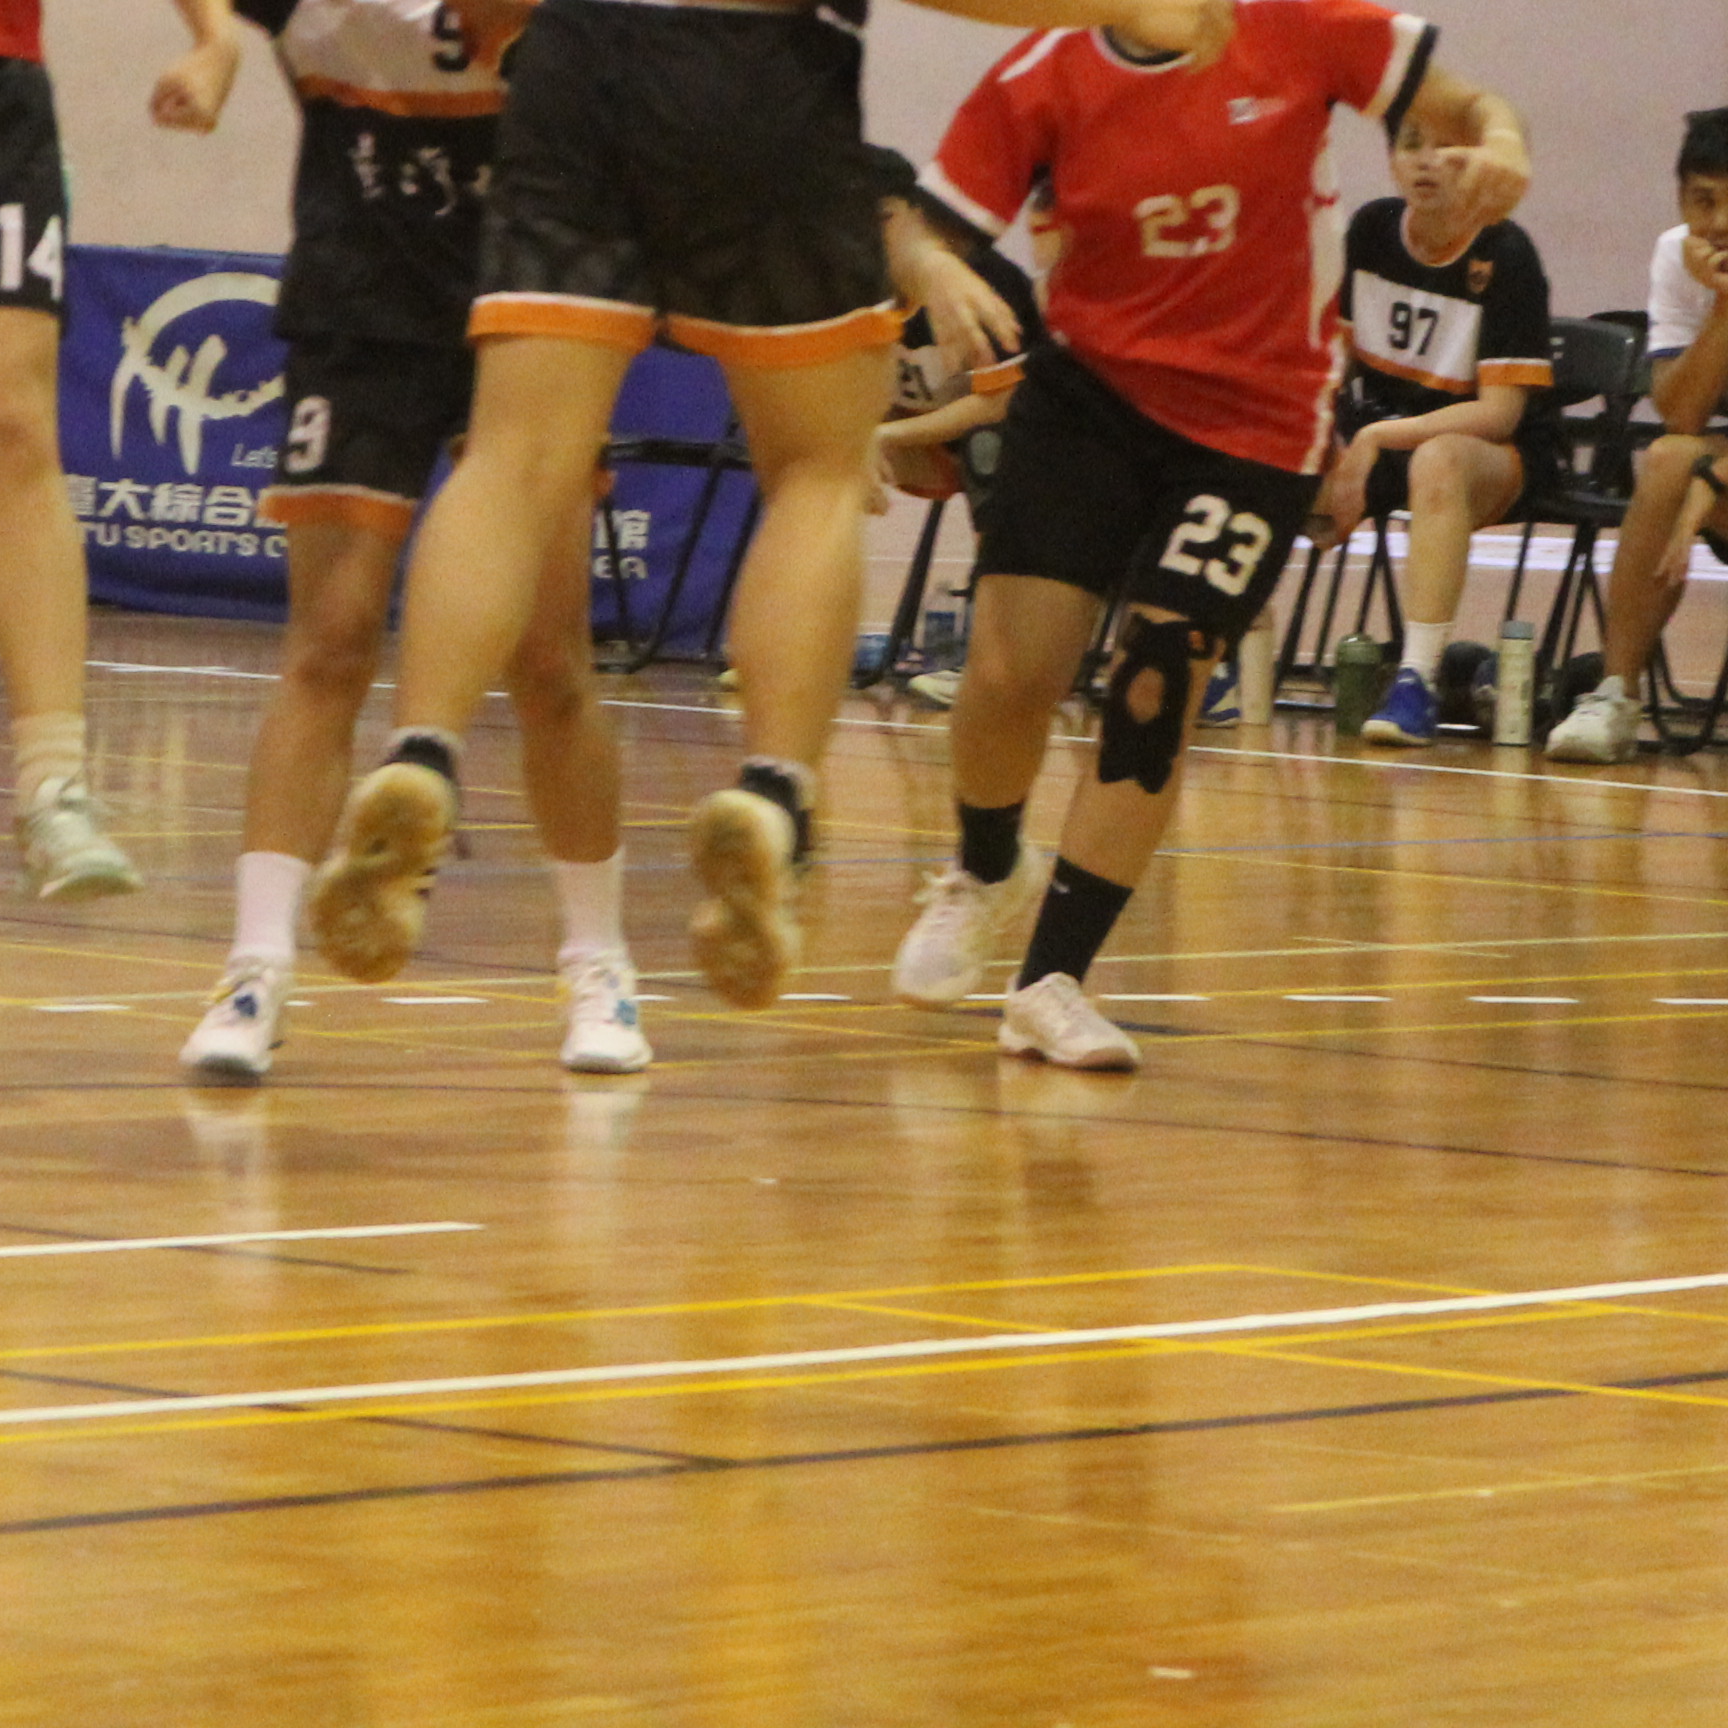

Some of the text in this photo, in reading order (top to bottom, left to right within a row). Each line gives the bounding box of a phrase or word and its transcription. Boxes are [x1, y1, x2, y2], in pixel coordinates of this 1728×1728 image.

[1132, 183, 1241, 259] 23
[1387, 300, 1440, 357] 97
[122, 524, 261, 558] SPORTS
[1157, 493, 1273, 596] 23
